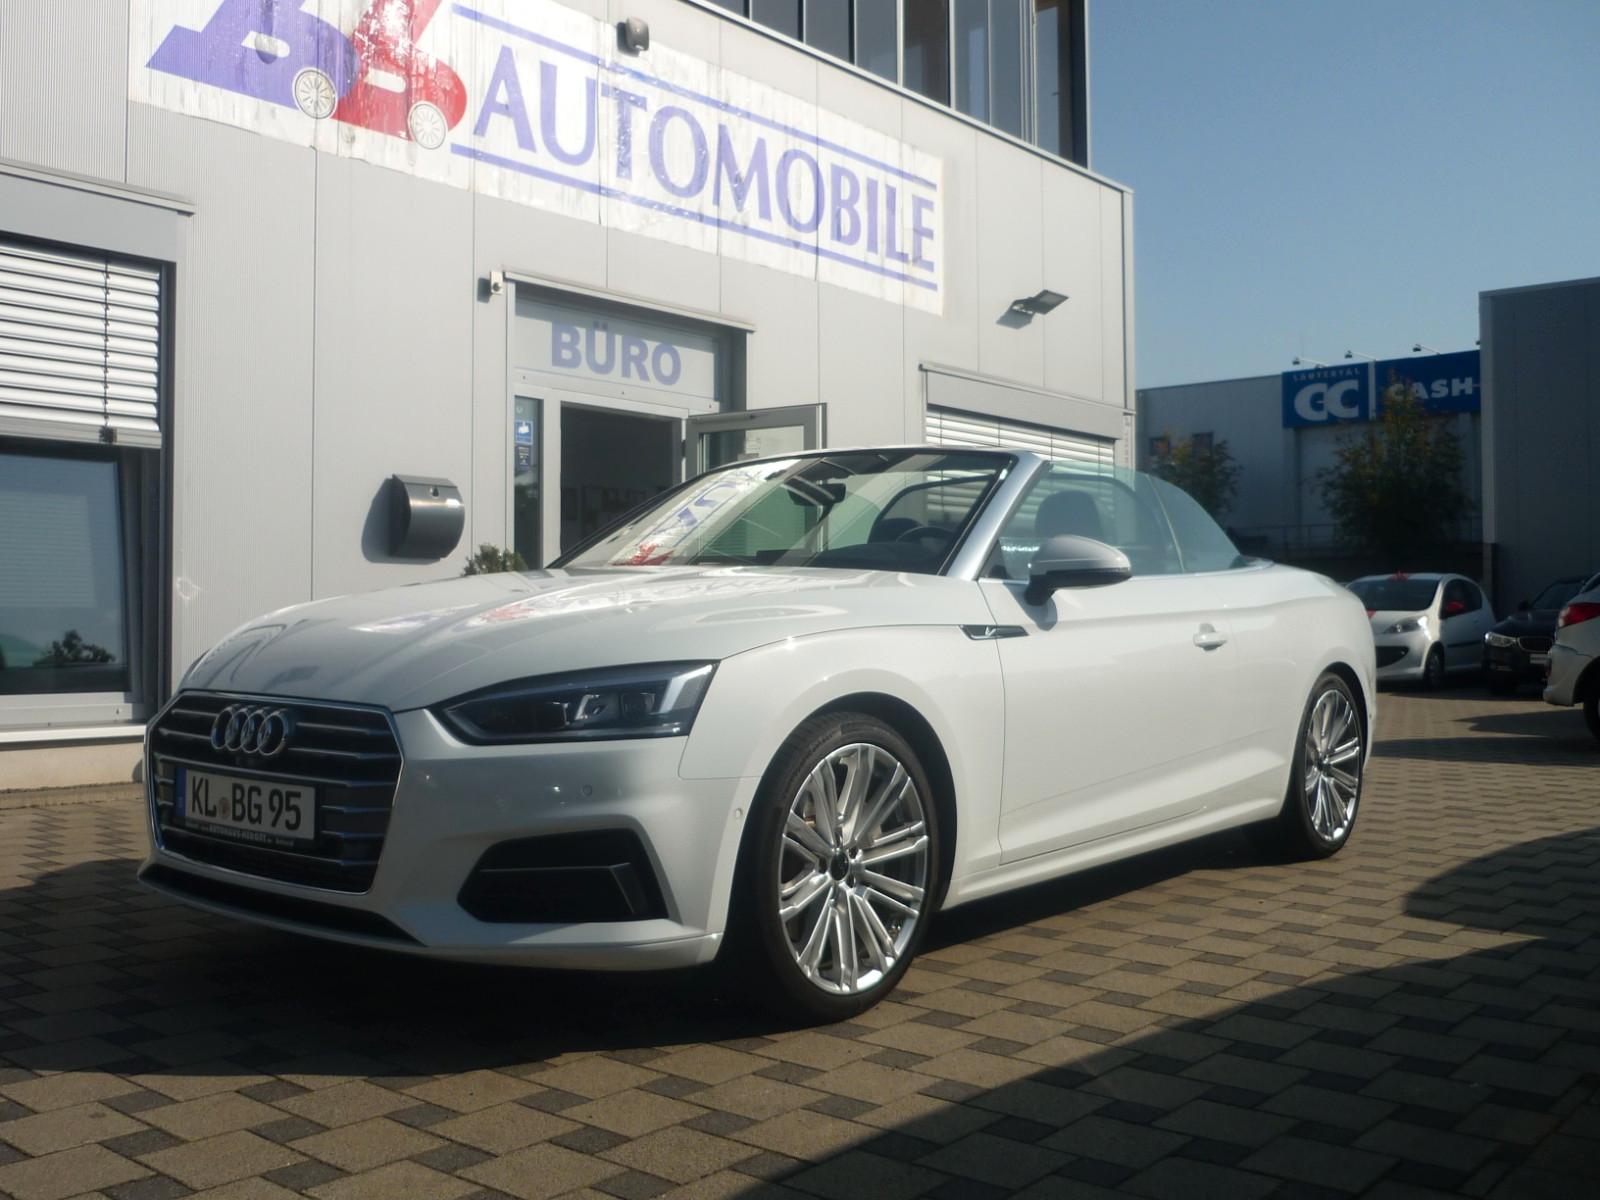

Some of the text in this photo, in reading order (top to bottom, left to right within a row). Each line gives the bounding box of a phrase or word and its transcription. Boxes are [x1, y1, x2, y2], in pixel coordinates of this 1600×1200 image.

[473, 45, 936, 273] AUTOMOBILE
[551, 320, 682, 386] BÜRO
[192, 777, 302, 830] KL BG 95
